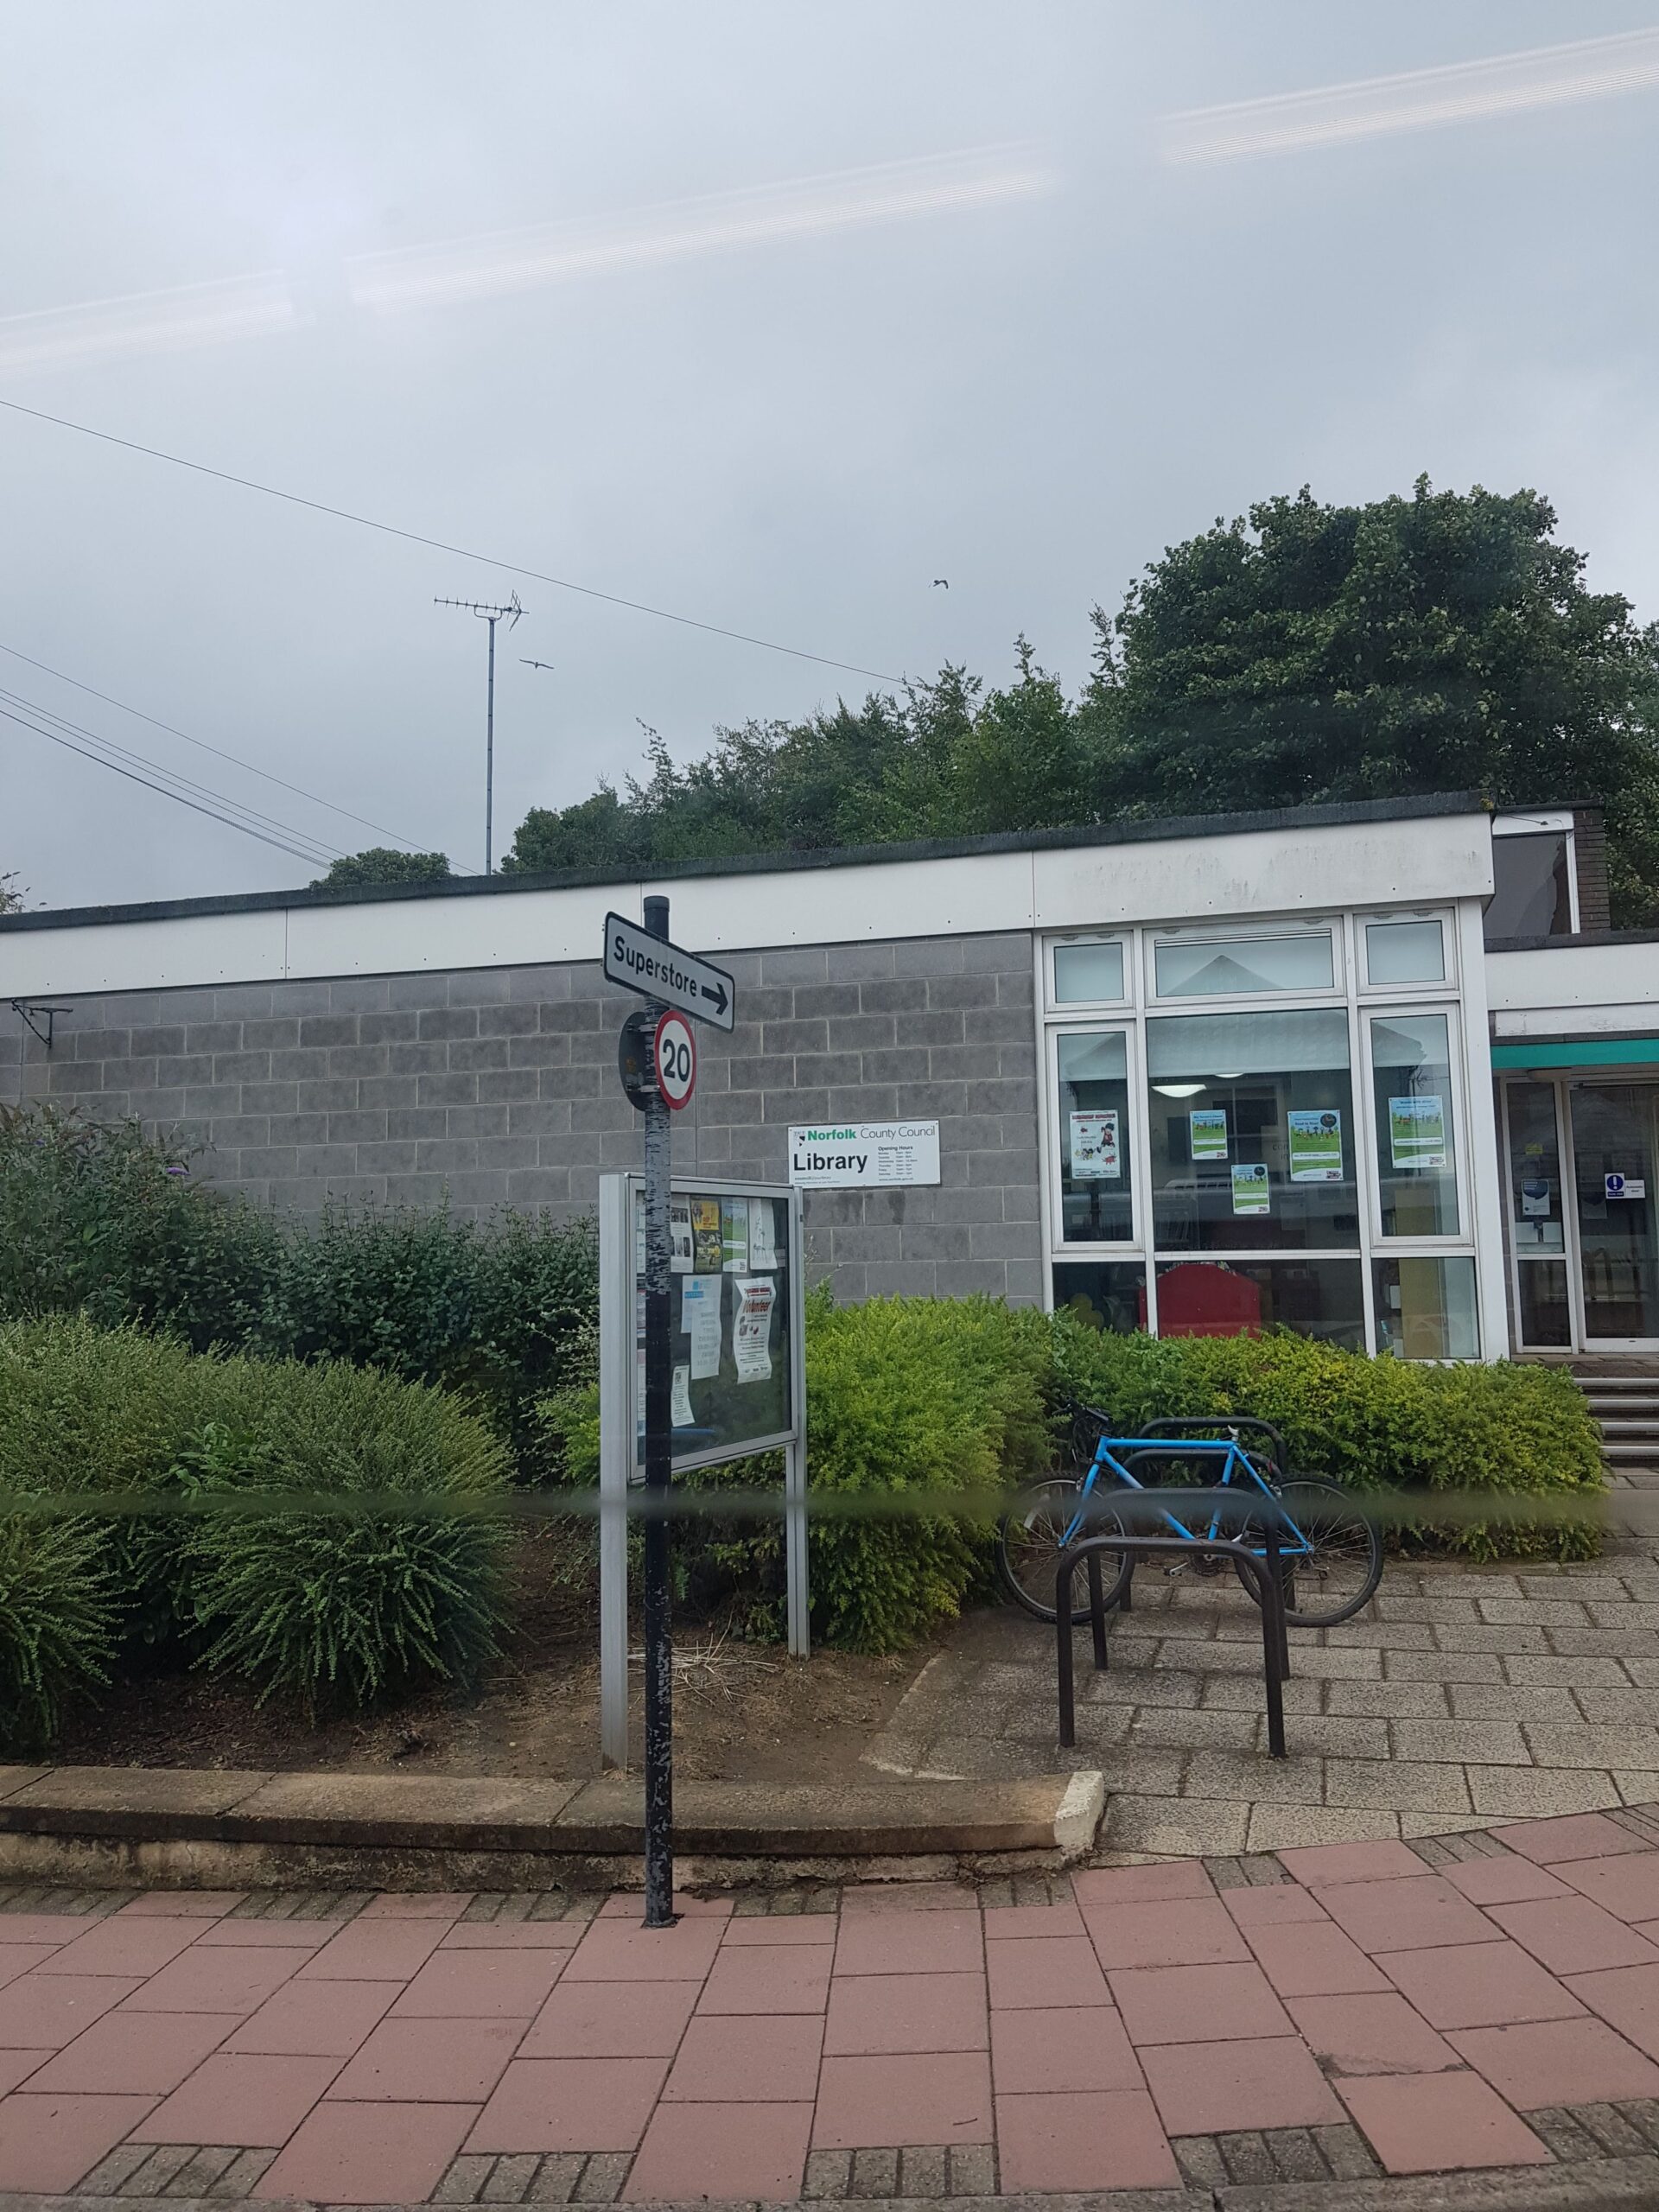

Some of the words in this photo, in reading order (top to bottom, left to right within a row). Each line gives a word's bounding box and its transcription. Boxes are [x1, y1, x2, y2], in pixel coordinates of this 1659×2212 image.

[613, 936, 697, 997] Superstore
[663, 1039, 690, 1083] 20
[807, 1128, 856, 1141] Norfolk
[860, 1127, 896, 1140] County
[899, 1125, 935, 1137] Council
[793, 1153, 868, 1173] Library
